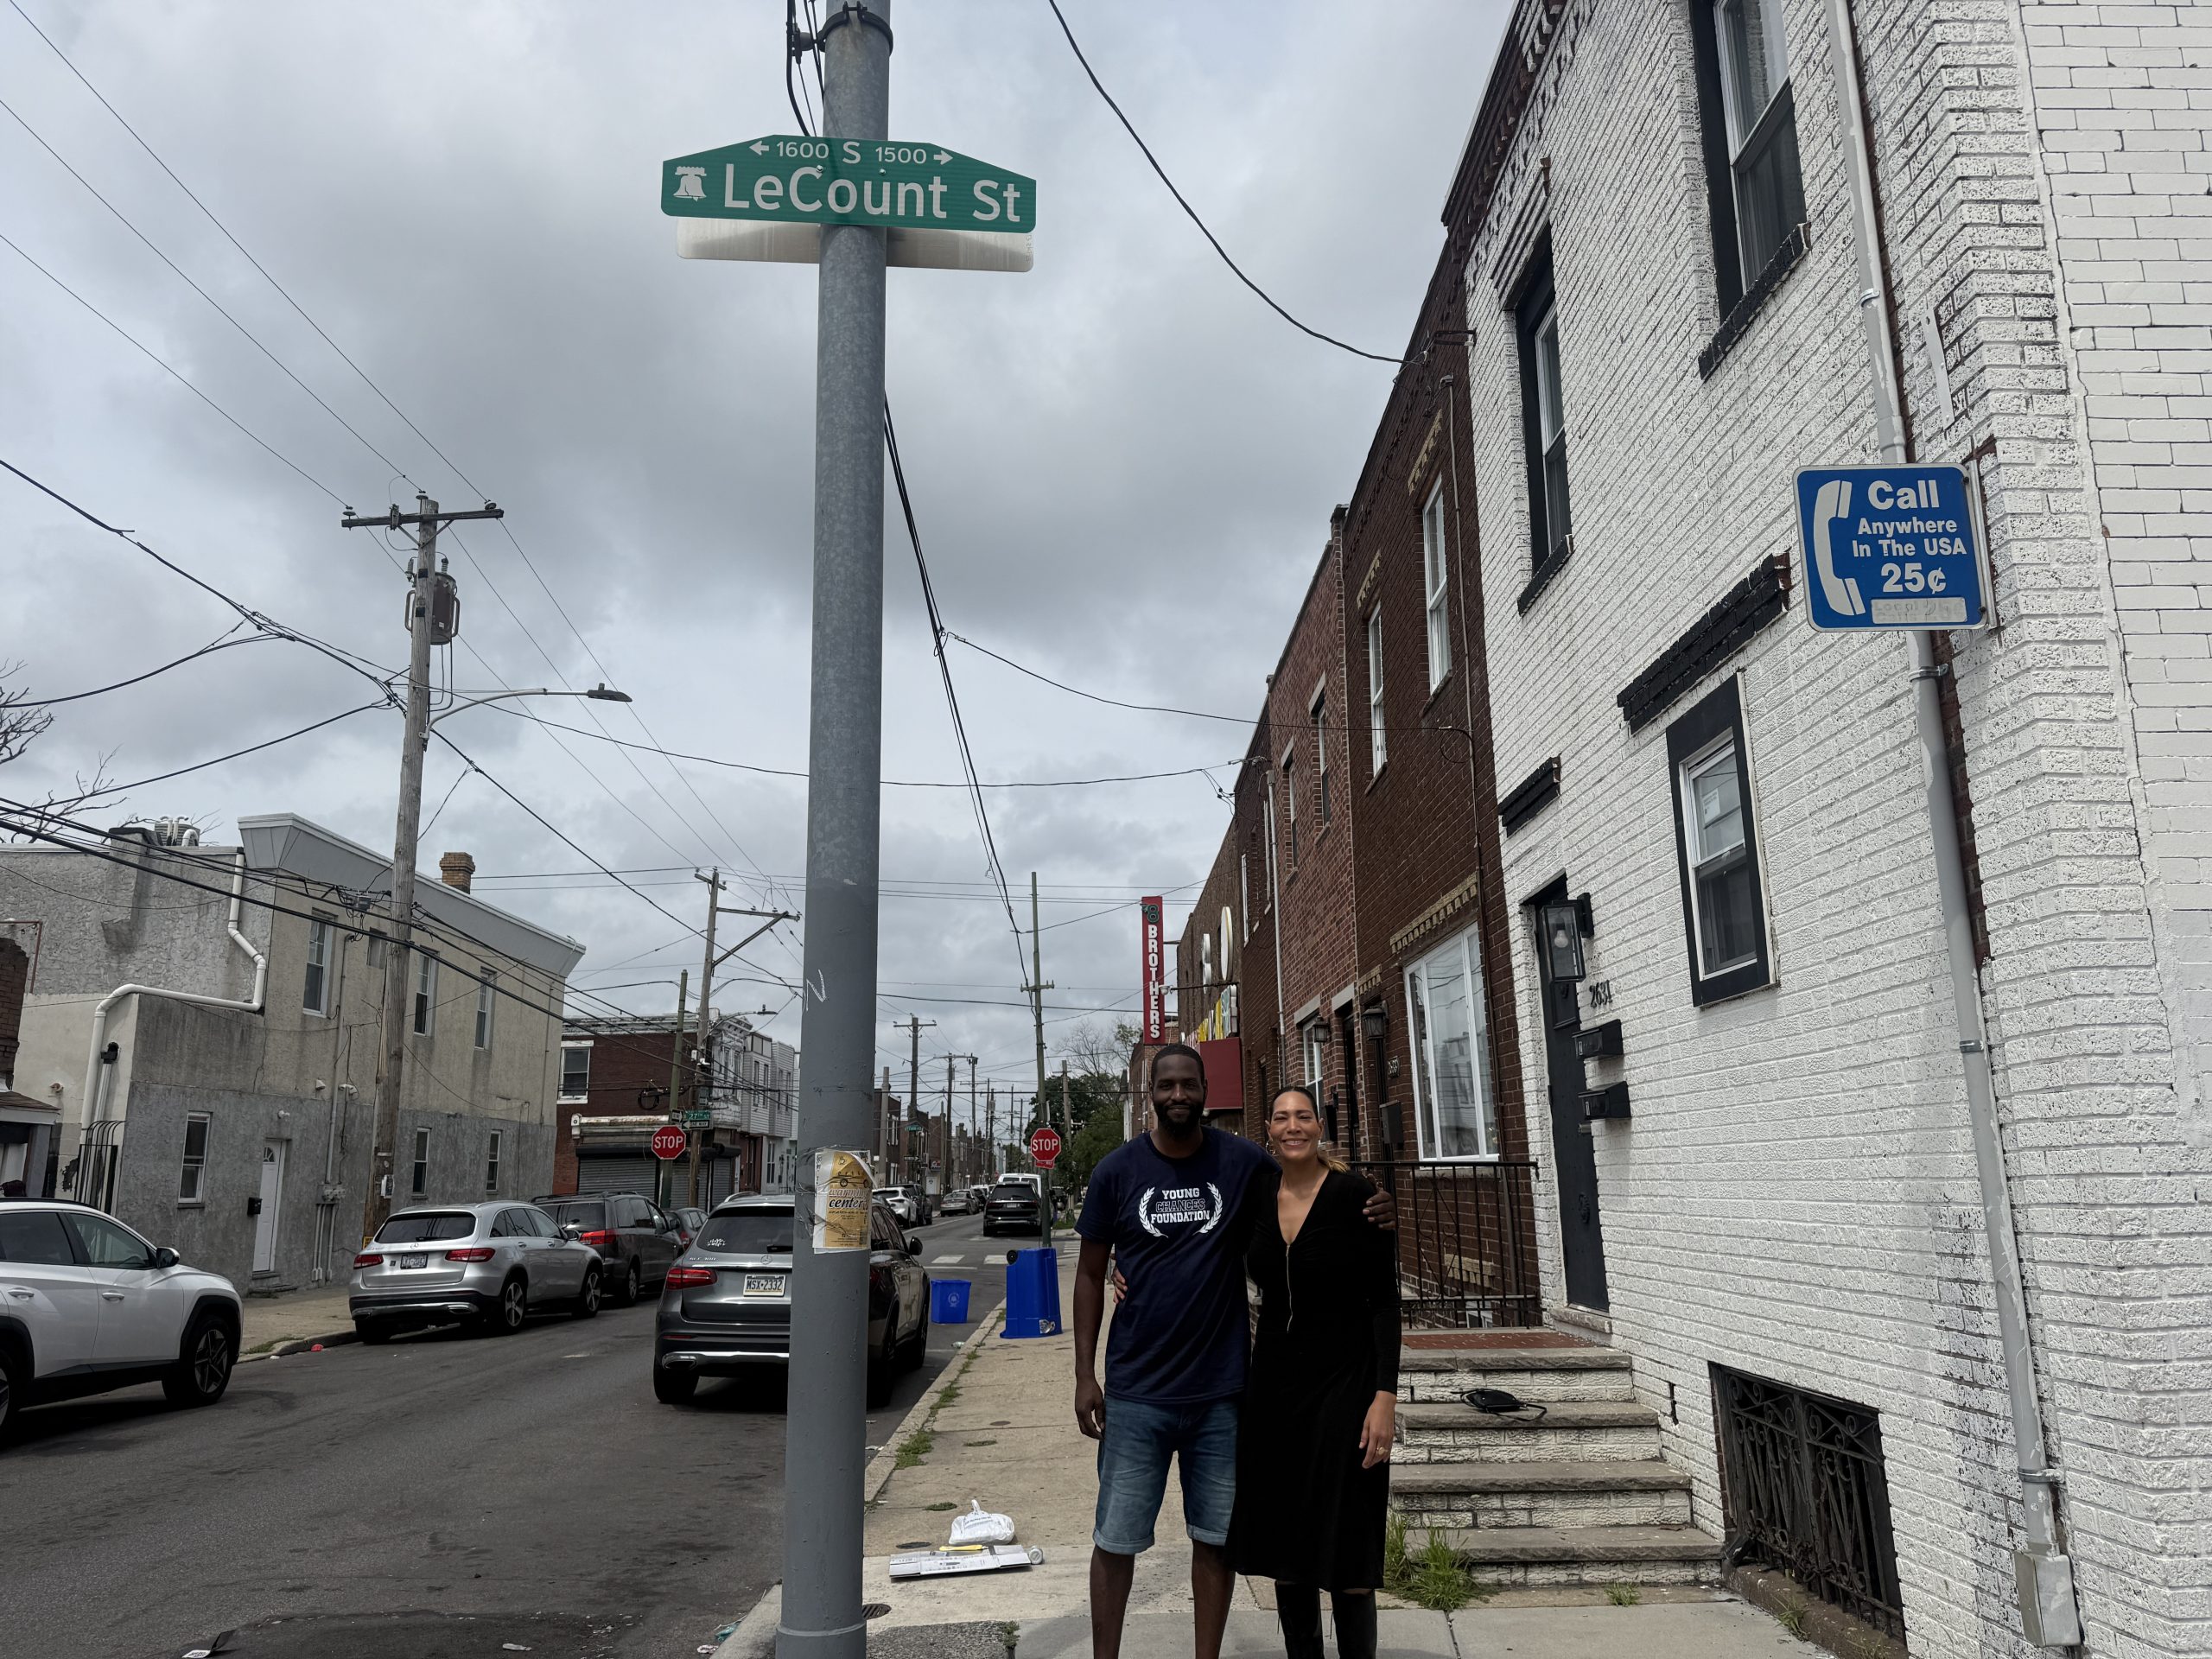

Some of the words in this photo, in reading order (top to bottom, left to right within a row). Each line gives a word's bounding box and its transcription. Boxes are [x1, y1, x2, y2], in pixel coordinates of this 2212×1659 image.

[776, 141, 830, 159] 1600
[842, 140, 861, 164] S
[875, 146, 927, 164] 1500
[724, 162, 948, 219] LeCount
[973, 179, 1020, 222] St
[1867, 480, 1940, 511] Call
[1858, 516, 1957, 538] Anywhere
[1852, 539, 1872, 557] In
[1878, 538, 1916, 557] The
[1923, 537, 1967, 556] USA
[1880, 563, 1947, 594] 25¢
[1147, 925, 1160, 1039] BROTHERS
[1589, 980, 1613, 1008] 2631
[654, 1135, 683, 1149] STOP
[1032, 1138, 1058, 1152] STOP
[829, 1197, 863, 1208] center
[1161, 1187, 1200, 1200] YOUNG
[1155, 1198, 1206, 1213] CHANCES
[1150, 1210, 1211, 1224] FOUNDATION
